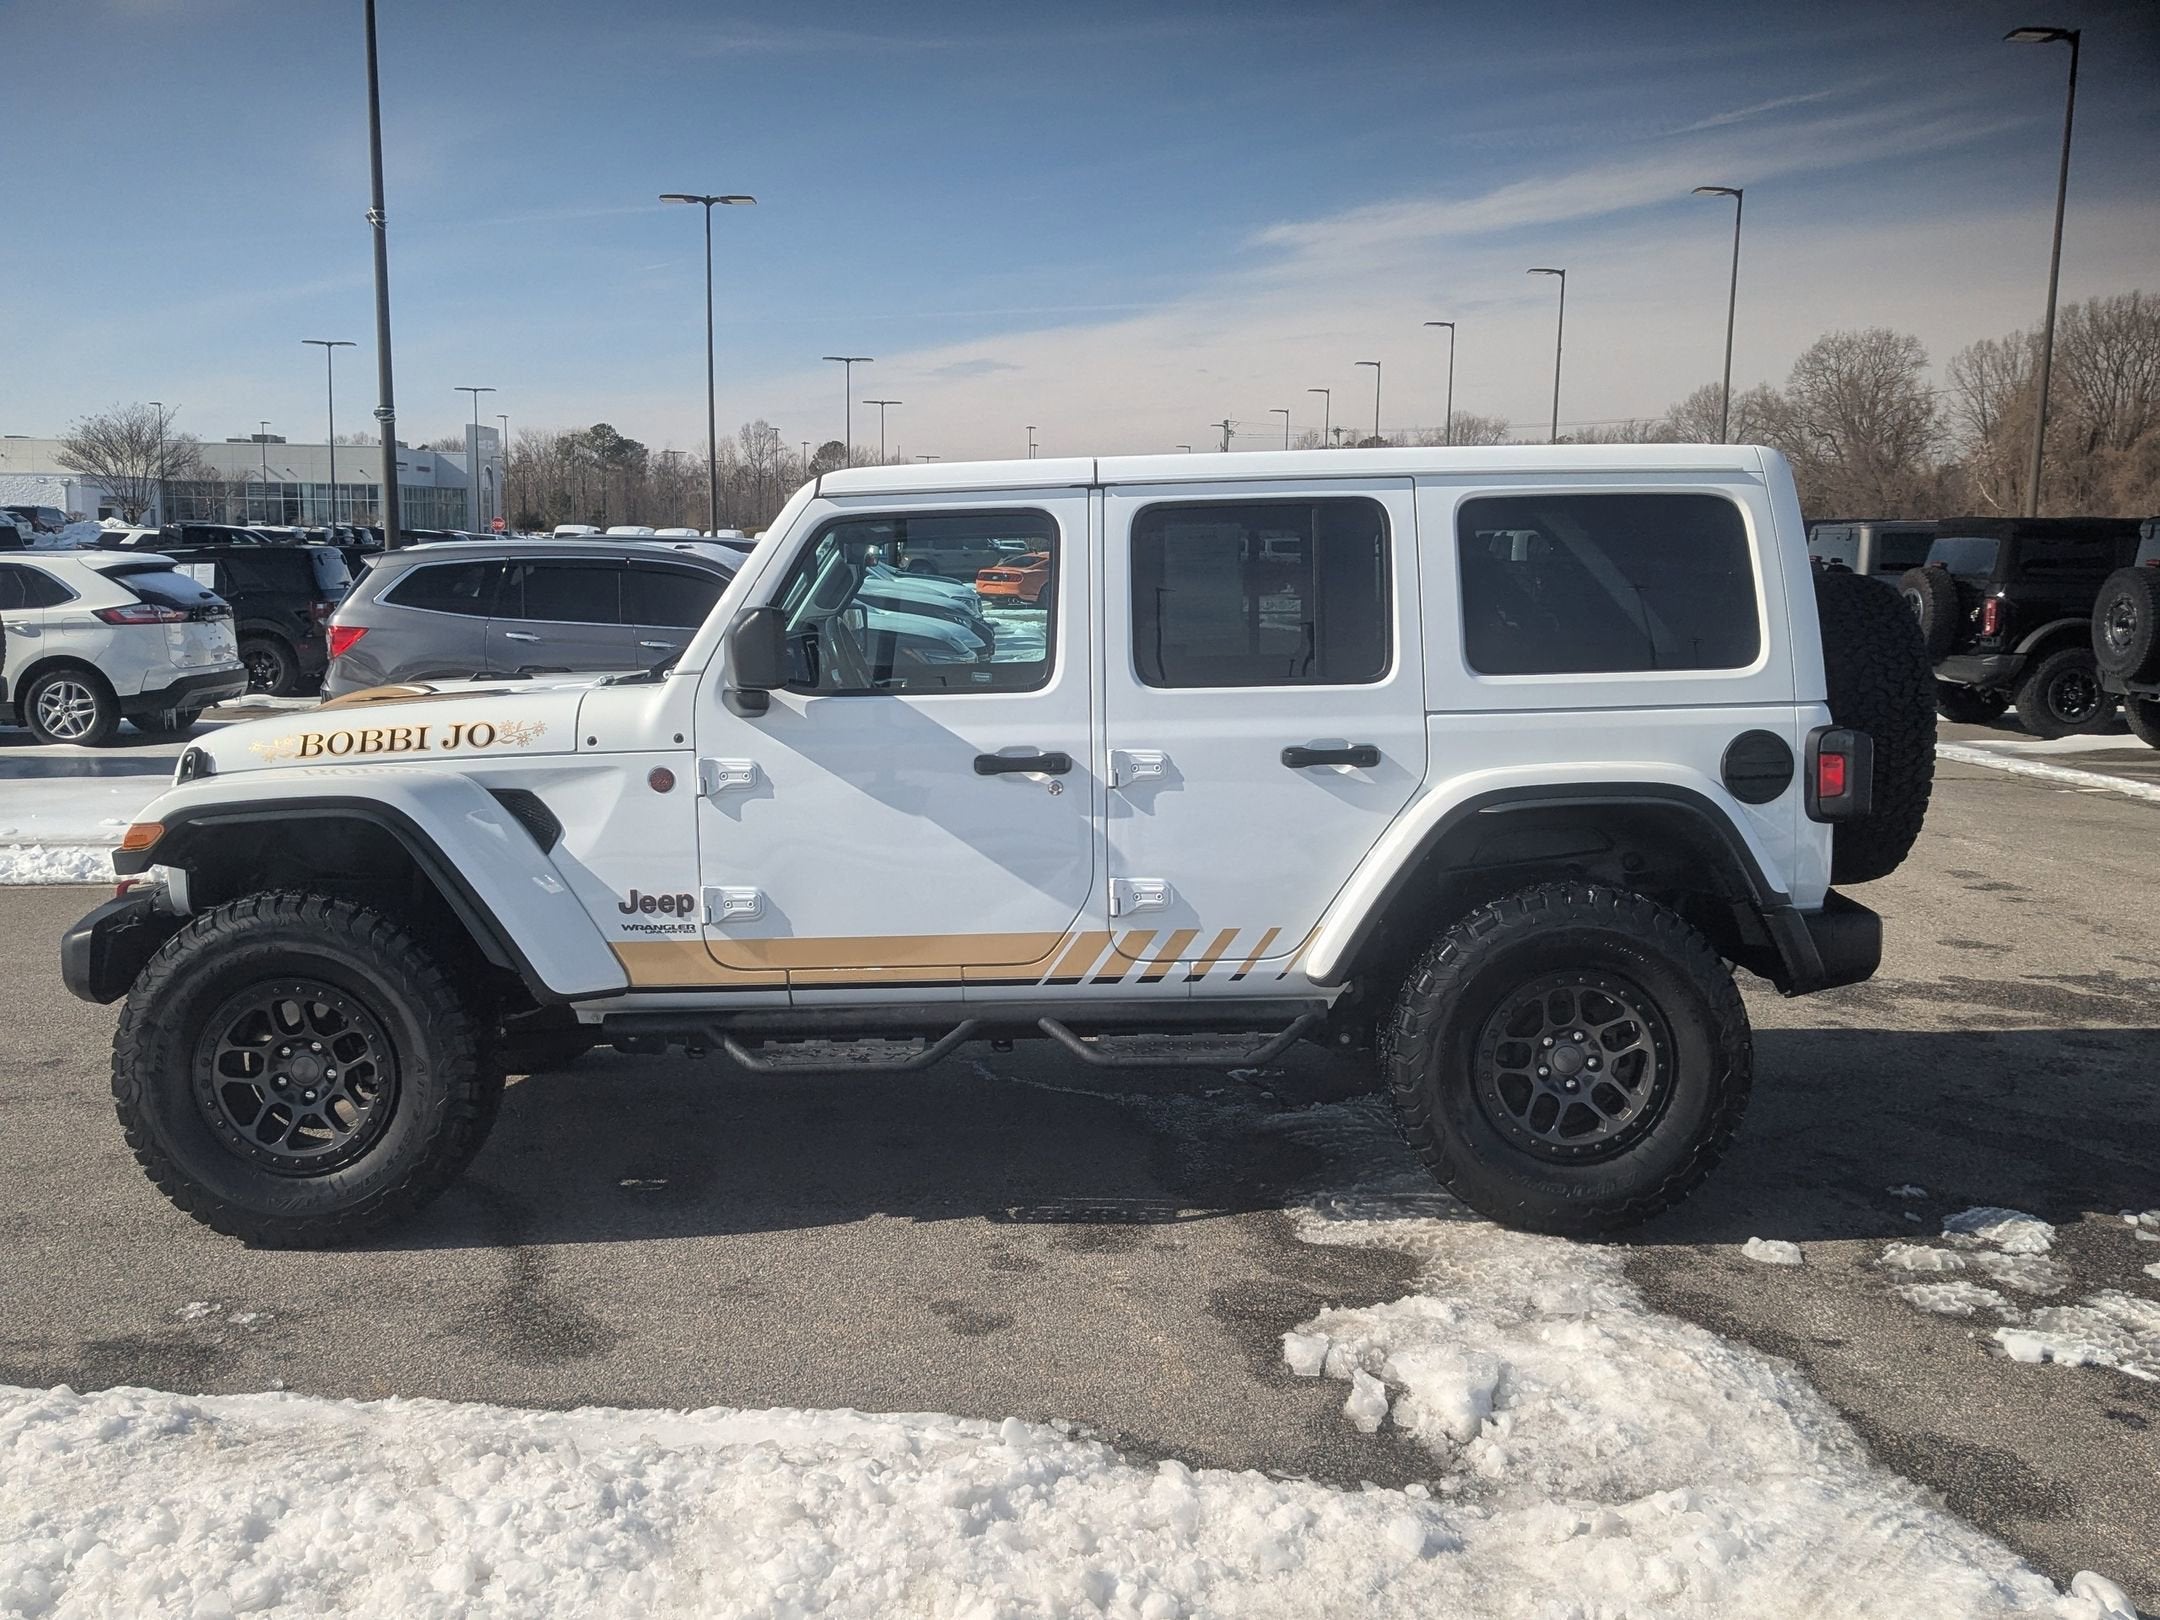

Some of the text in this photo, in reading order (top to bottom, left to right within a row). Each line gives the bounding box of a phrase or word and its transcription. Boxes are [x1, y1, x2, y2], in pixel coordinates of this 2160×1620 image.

[296, 722, 497, 760] BOBBI JO
[618, 889, 695, 918] Jeep
[621, 923, 696, 931] WRANGLER
